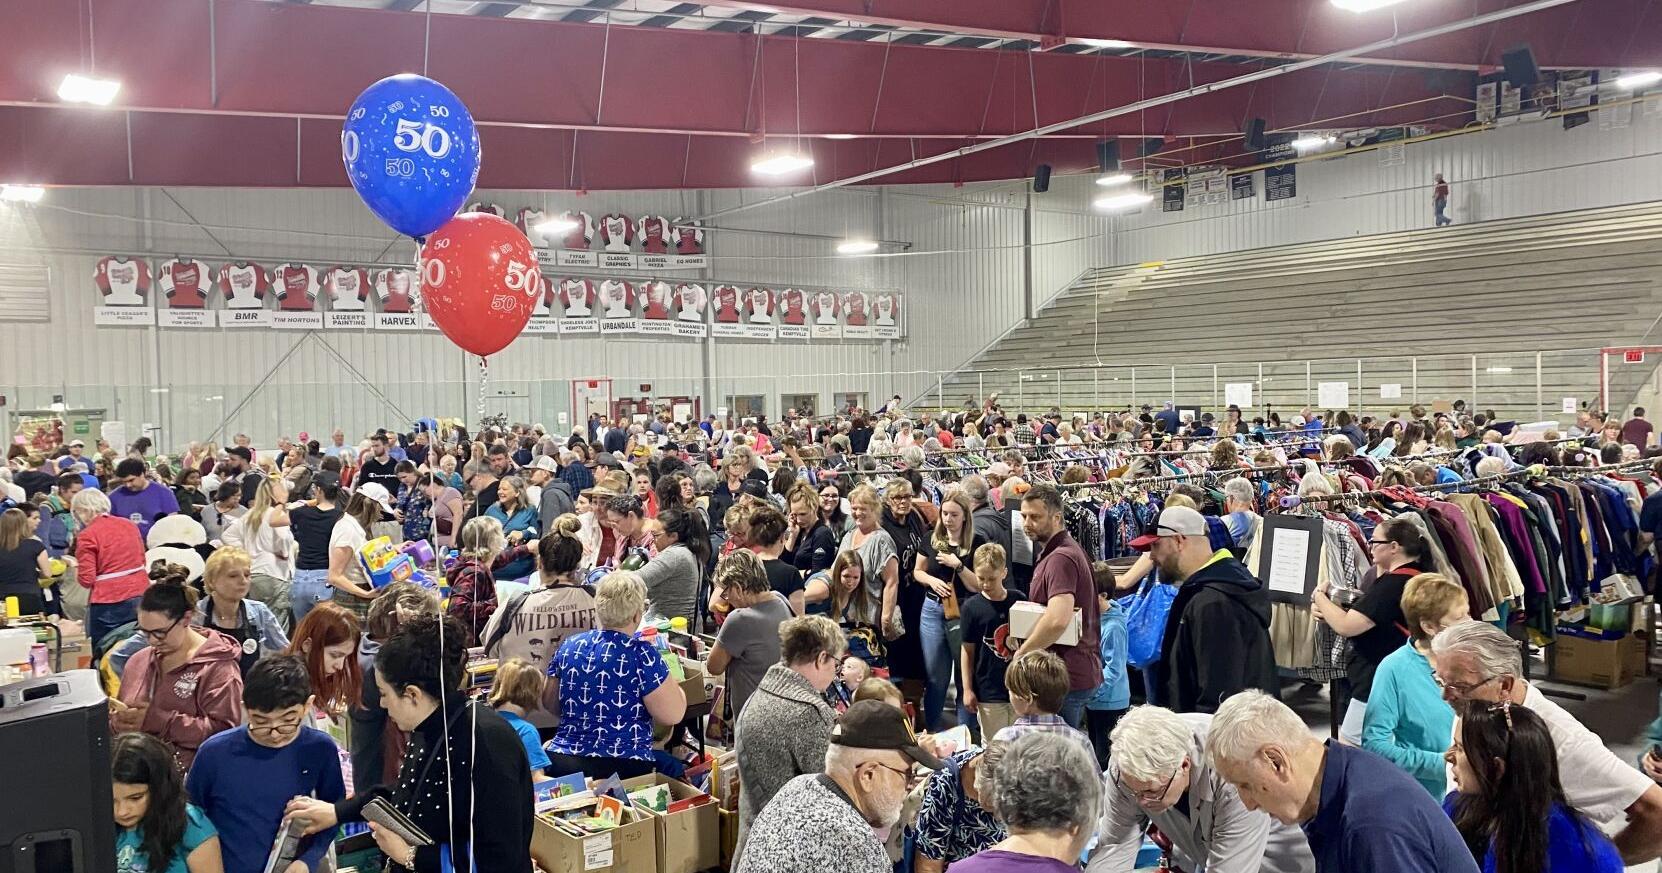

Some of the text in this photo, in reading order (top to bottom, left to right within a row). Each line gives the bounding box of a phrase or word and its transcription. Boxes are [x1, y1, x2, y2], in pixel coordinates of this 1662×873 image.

[351, 107, 366, 120] 50
[430, 105, 449, 118] 50
[393, 117, 451, 159] 50
[343, 130, 360, 163] 0
[385, 158, 415, 176] 50
[440, 168, 450, 178] 50
[434, 238, 450, 250] 50
[505, 260, 539, 297] 50
[491, 294, 516, 311] 50
[235, 312, 258, 320] BMR
[381, 317, 417, 326] HARVEX
[602, 321, 636, 330] URBANDALE
[1627, 352, 1642, 360] EXIT
[533, 603, 578, 613] YELLOWSTONE
[515, 607, 598, 637] WILDLIFE
